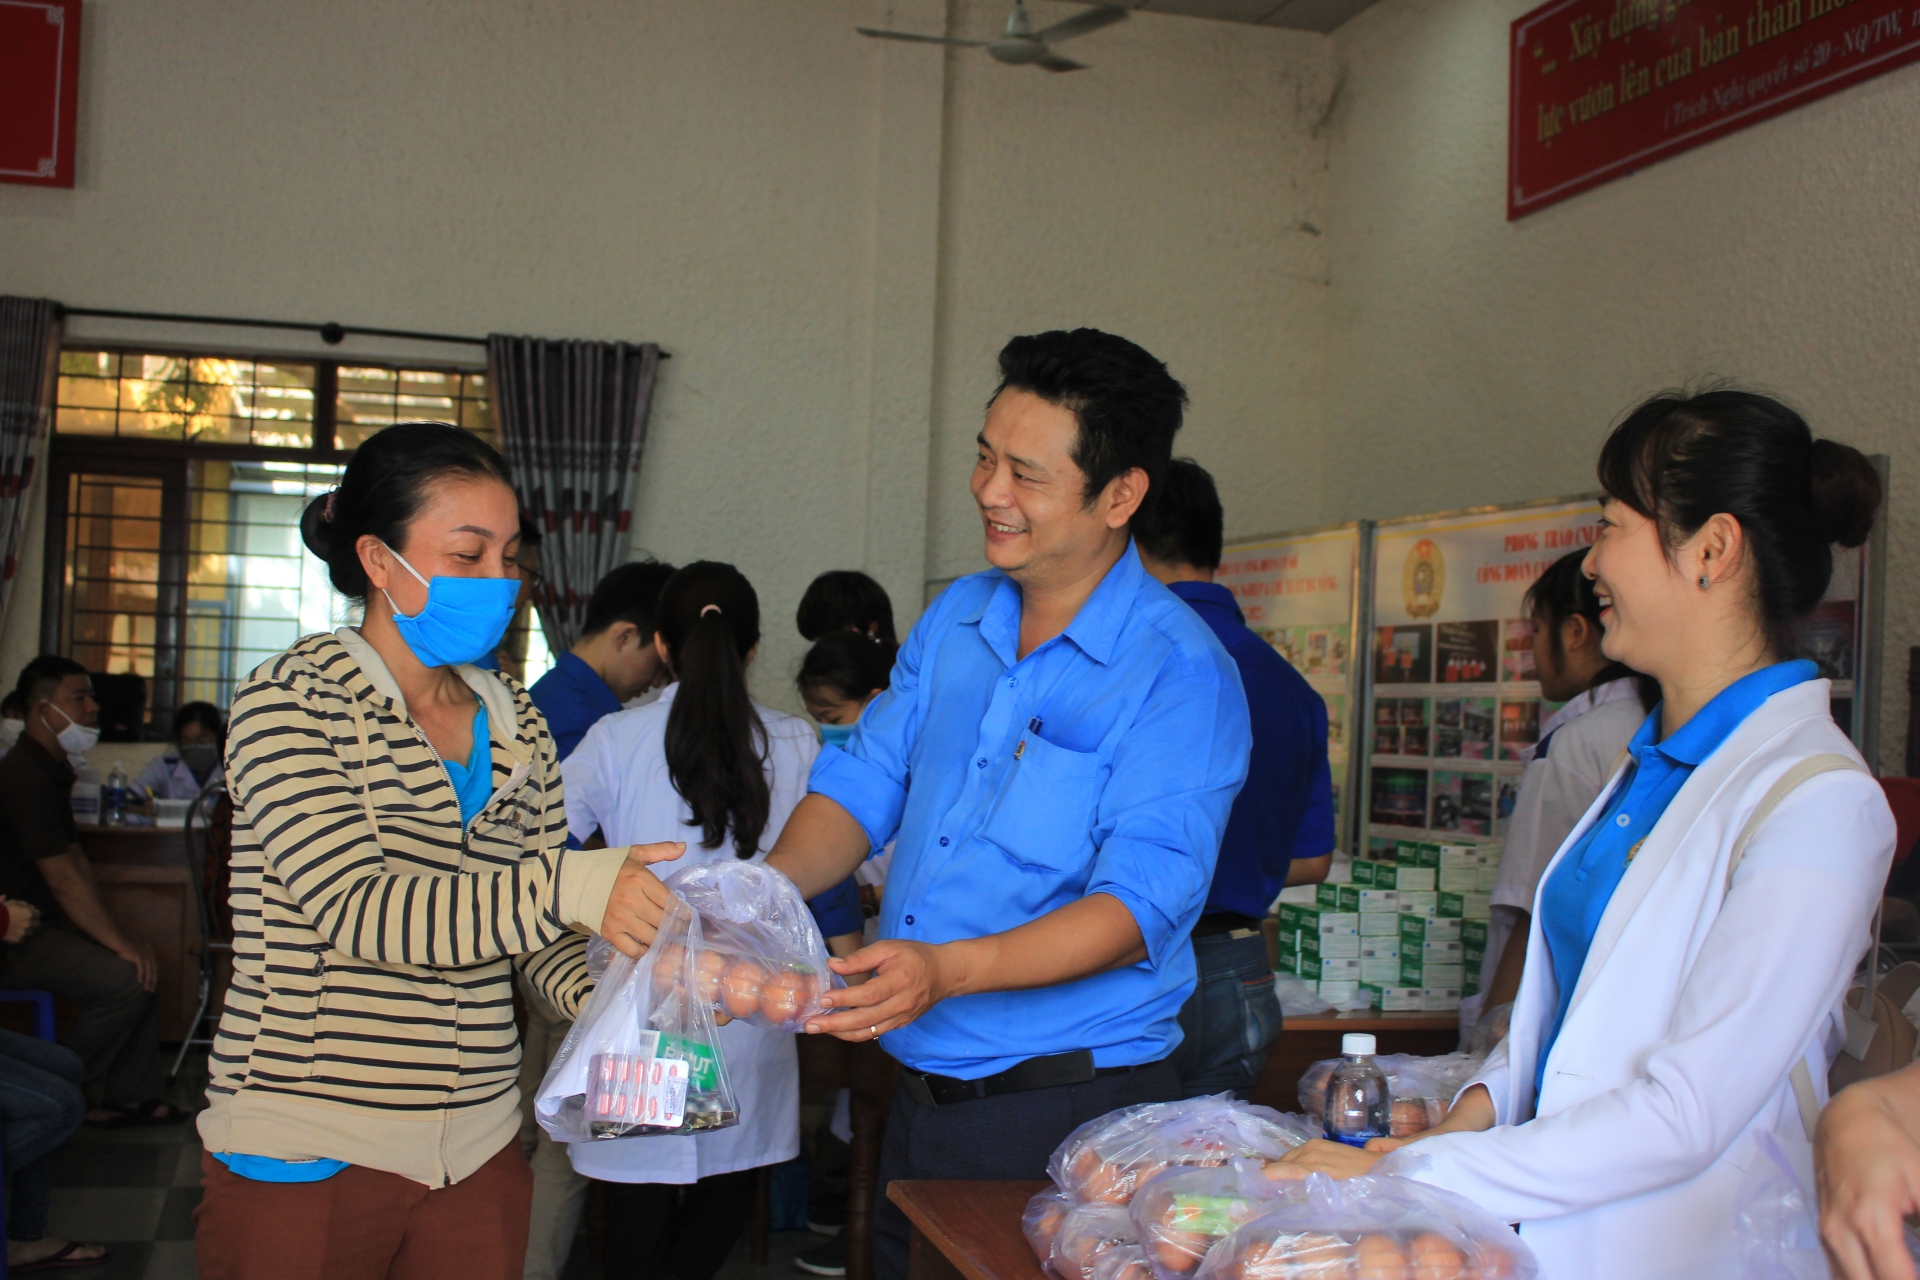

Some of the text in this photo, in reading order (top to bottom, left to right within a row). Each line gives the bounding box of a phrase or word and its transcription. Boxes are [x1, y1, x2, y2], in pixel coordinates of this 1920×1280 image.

[1620, 60, 1651, 105] lên
[1655, 35, 1694, 88] của
[1701, 13, 1740, 68] bản
